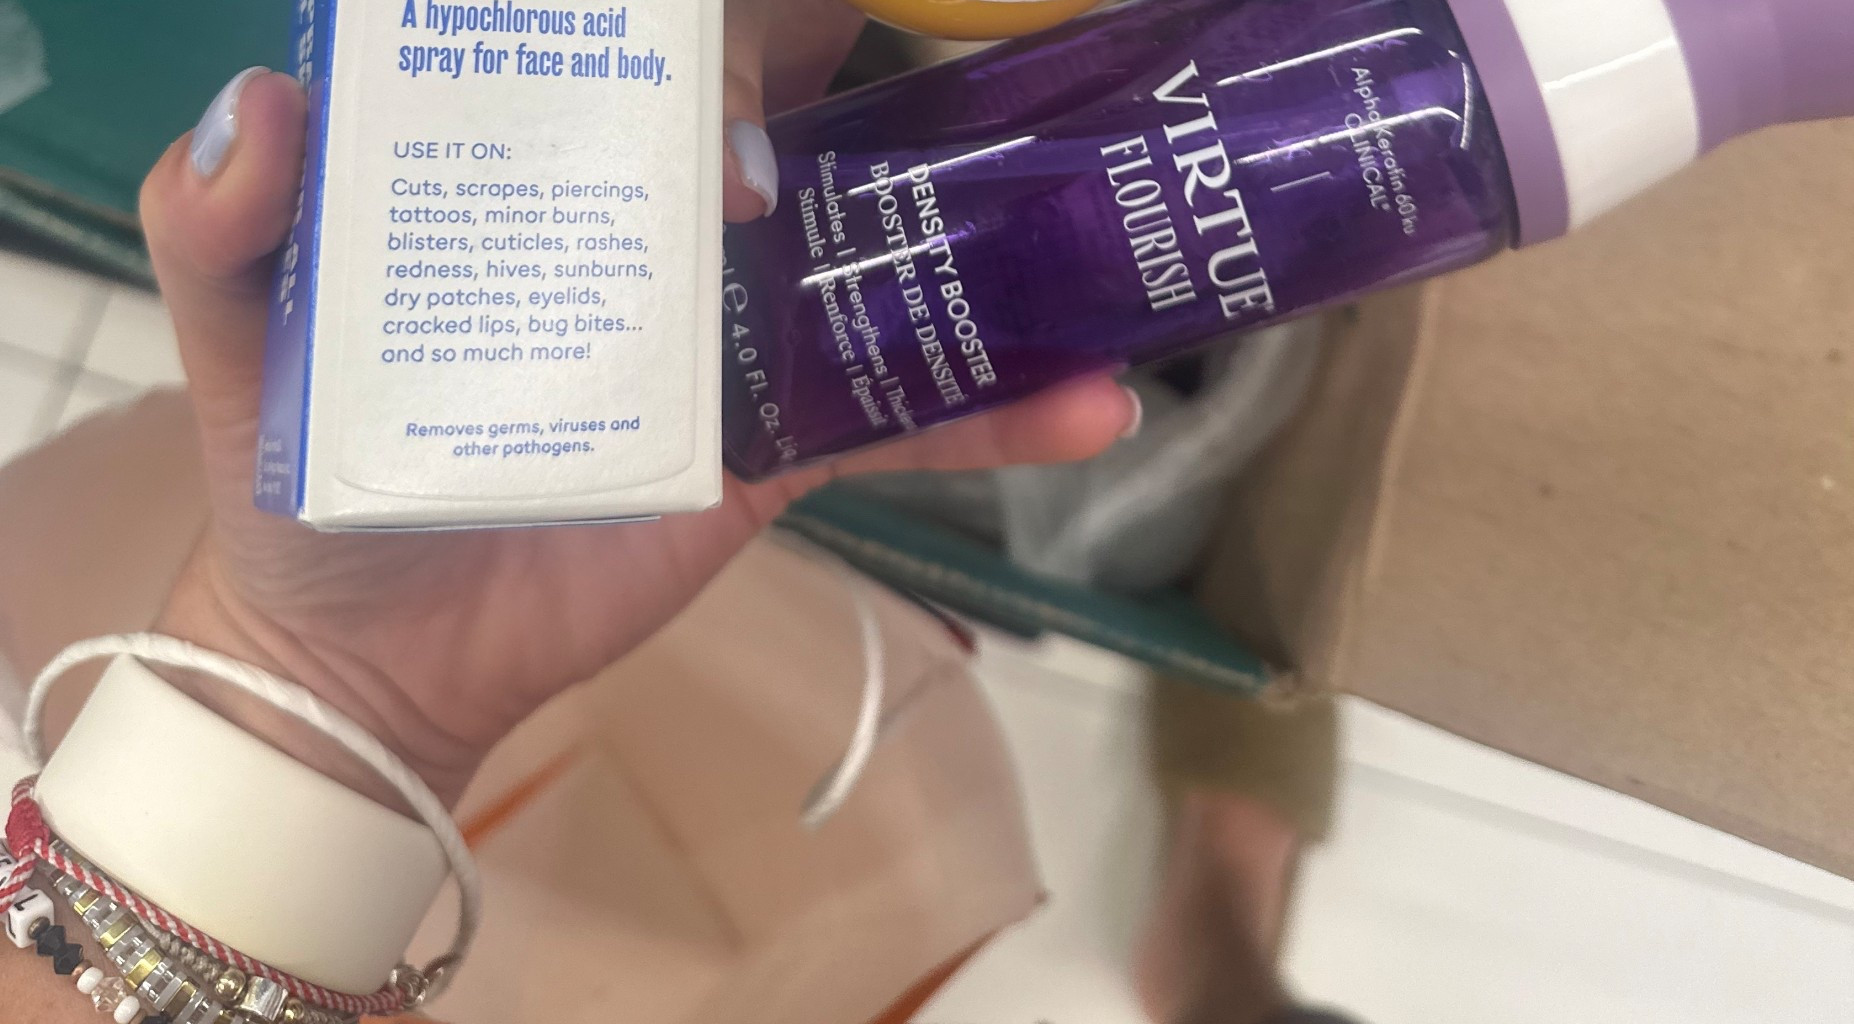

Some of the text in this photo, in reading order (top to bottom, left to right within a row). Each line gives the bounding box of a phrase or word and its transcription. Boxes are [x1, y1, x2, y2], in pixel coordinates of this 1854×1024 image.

[583, 7, 626, 38] acid
[399, 41, 671, 86] spray for face and body.
[394, 142, 511, 160] USE IT ON:
[391, 178, 648, 202] Cuts, scrapes, piercings,
[1152, 59, 1276, 320] VIRTUE
[389, 206, 615, 227] tattoos, minor burns,
[1100, 134, 1197, 312] FLOURISH
[387, 232, 648, 253] blisters, cuticles, rashes,
[386, 260, 653, 281] redness, hives, sunburns,
[798, 187, 825, 259] Stimule
[818, 275, 856, 362] Renforce
[817, 149, 847, 244] Stimulates
[841, 261, 888, 377] Strengthens
[870, 160, 970, 407] BOOSTER DE DENSITÉ
[907, 163, 997, 389] DENSITY BOOSTER
[384, 287, 606, 311] dry patches, eyelids,
[383, 313, 642, 337] cracked lips, bug bites...
[381, 342, 590, 363] and so much more!
[731, 323, 758, 363] 4.0
[745, 369, 769, 400] Fl.
[759, 402, 782, 435] Oz.
[405, 416, 640, 439] Removes germs, viruses and
[452, 439, 594, 458] other pathogens.
